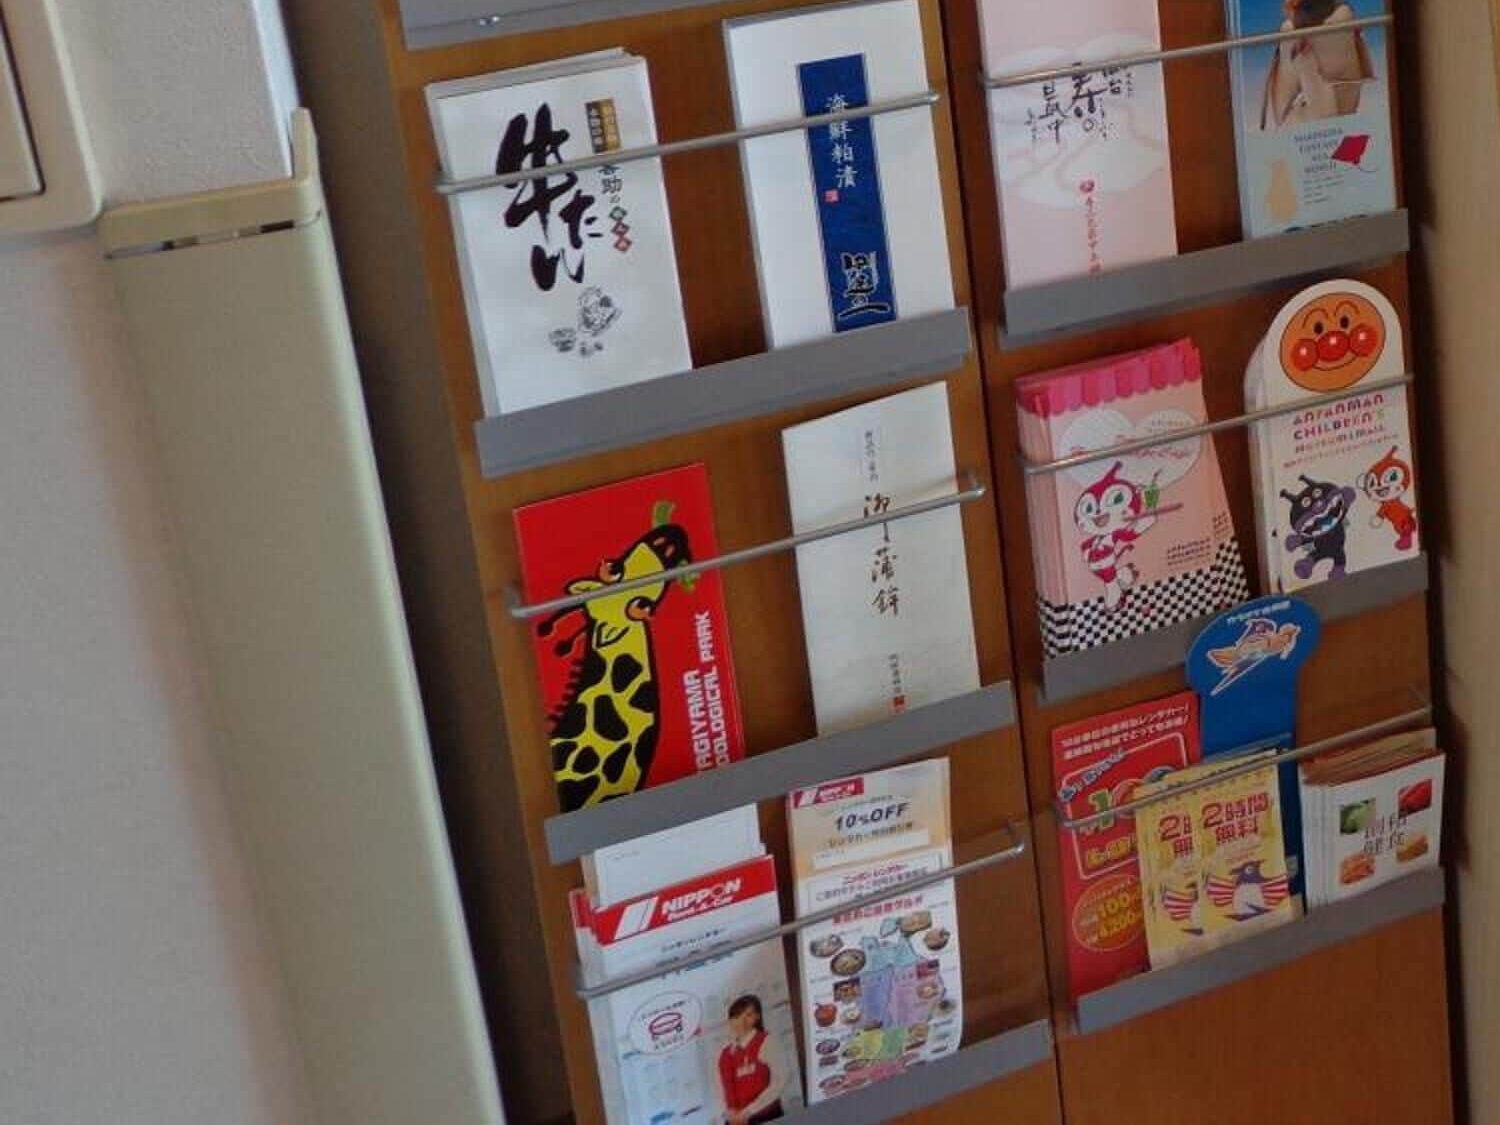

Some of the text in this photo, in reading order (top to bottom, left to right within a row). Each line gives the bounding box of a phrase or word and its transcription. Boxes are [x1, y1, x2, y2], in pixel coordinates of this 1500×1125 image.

[694, 610, 715, 663] PARK
[683, 669, 713, 770] AGIYAMA
[835, 801, 911, 831] 10%OFF
[662, 877, 742, 914] NIPPON
